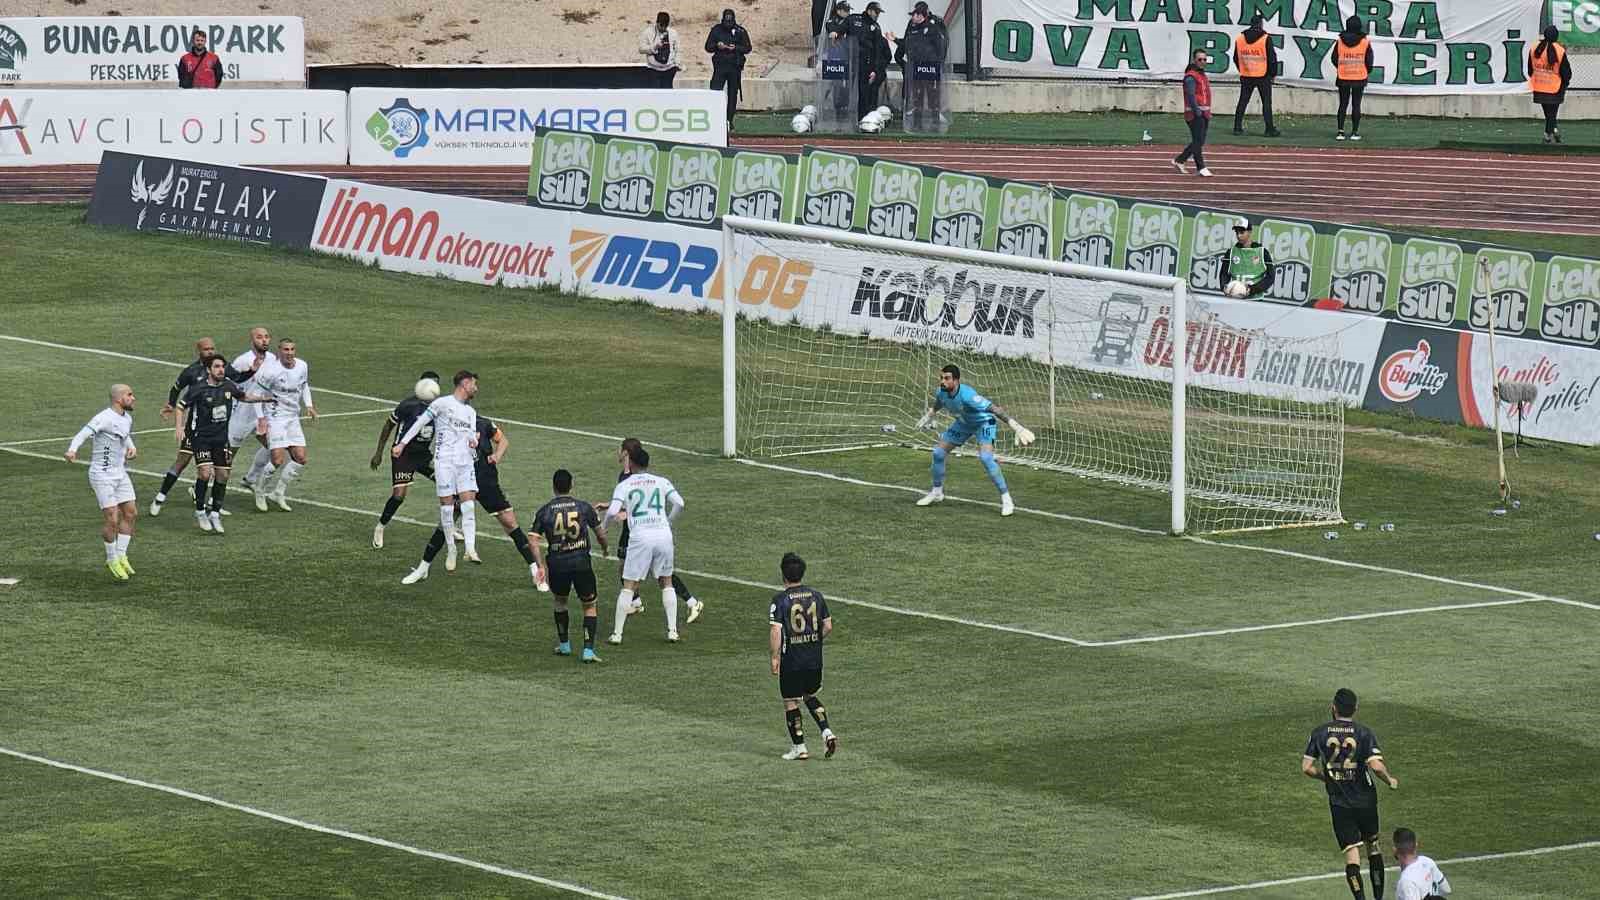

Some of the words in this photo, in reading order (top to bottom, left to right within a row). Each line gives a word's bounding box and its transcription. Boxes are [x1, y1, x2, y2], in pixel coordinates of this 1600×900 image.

[1075, 0, 1443, 39] MARMARA
[208, 24, 286, 53] PARK
[992, 20, 1150, 70] OVA
[41, 118, 130, 144] AVCI
[159, 112, 335, 144] LOJİSTİK
[435, 108, 627, 132] MARMARA
[635, 108, 710, 132] OSB
[544, 137, 590, 171] tek
[607, 144, 655, 179] tek
[671, 150, 717, 184] tek
[540, 171, 588, 205] süt
[735, 158, 783, 191] tek
[810, 157, 854, 192] tek
[874, 166, 917, 205] tek
[172, 177, 276, 221] RELAX
[604, 179, 651, 213] süt
[668, 186, 714, 220] süt
[732, 192, 779, 223] süt
[806, 192, 853, 229] süt
[938, 177, 984, 216] tek
[1002, 189, 1049, 224] tek
[318, 187, 440, 260] liman
[870, 204, 916, 240] süt
[933, 215, 982, 248] süt
[1068, 201, 1114, 236] tek
[1131, 209, 1179, 246] tek
[999, 226, 1048, 259] süt
[1064, 237, 1111, 268] süt
[1263, 227, 1311, 260] tek
[1337, 235, 1386, 272] tek
[1128, 246, 1175, 276] süt
[1404, 246, 1458, 284] tek
[1332, 273, 1383, 311] süt
[1549, 264, 1600, 301] tek
[1401, 285, 1453, 323] süt
[1544, 302, 1598, 340] süt
[1389, 364, 1445, 394] Bupiliç
[1535, 375, 1600, 425] piliç!
[628, 487, 663, 517] 24
[553, 511, 580, 539] 45
[790, 601, 818, 632] 61
[1326, 736, 1358, 769] 22
